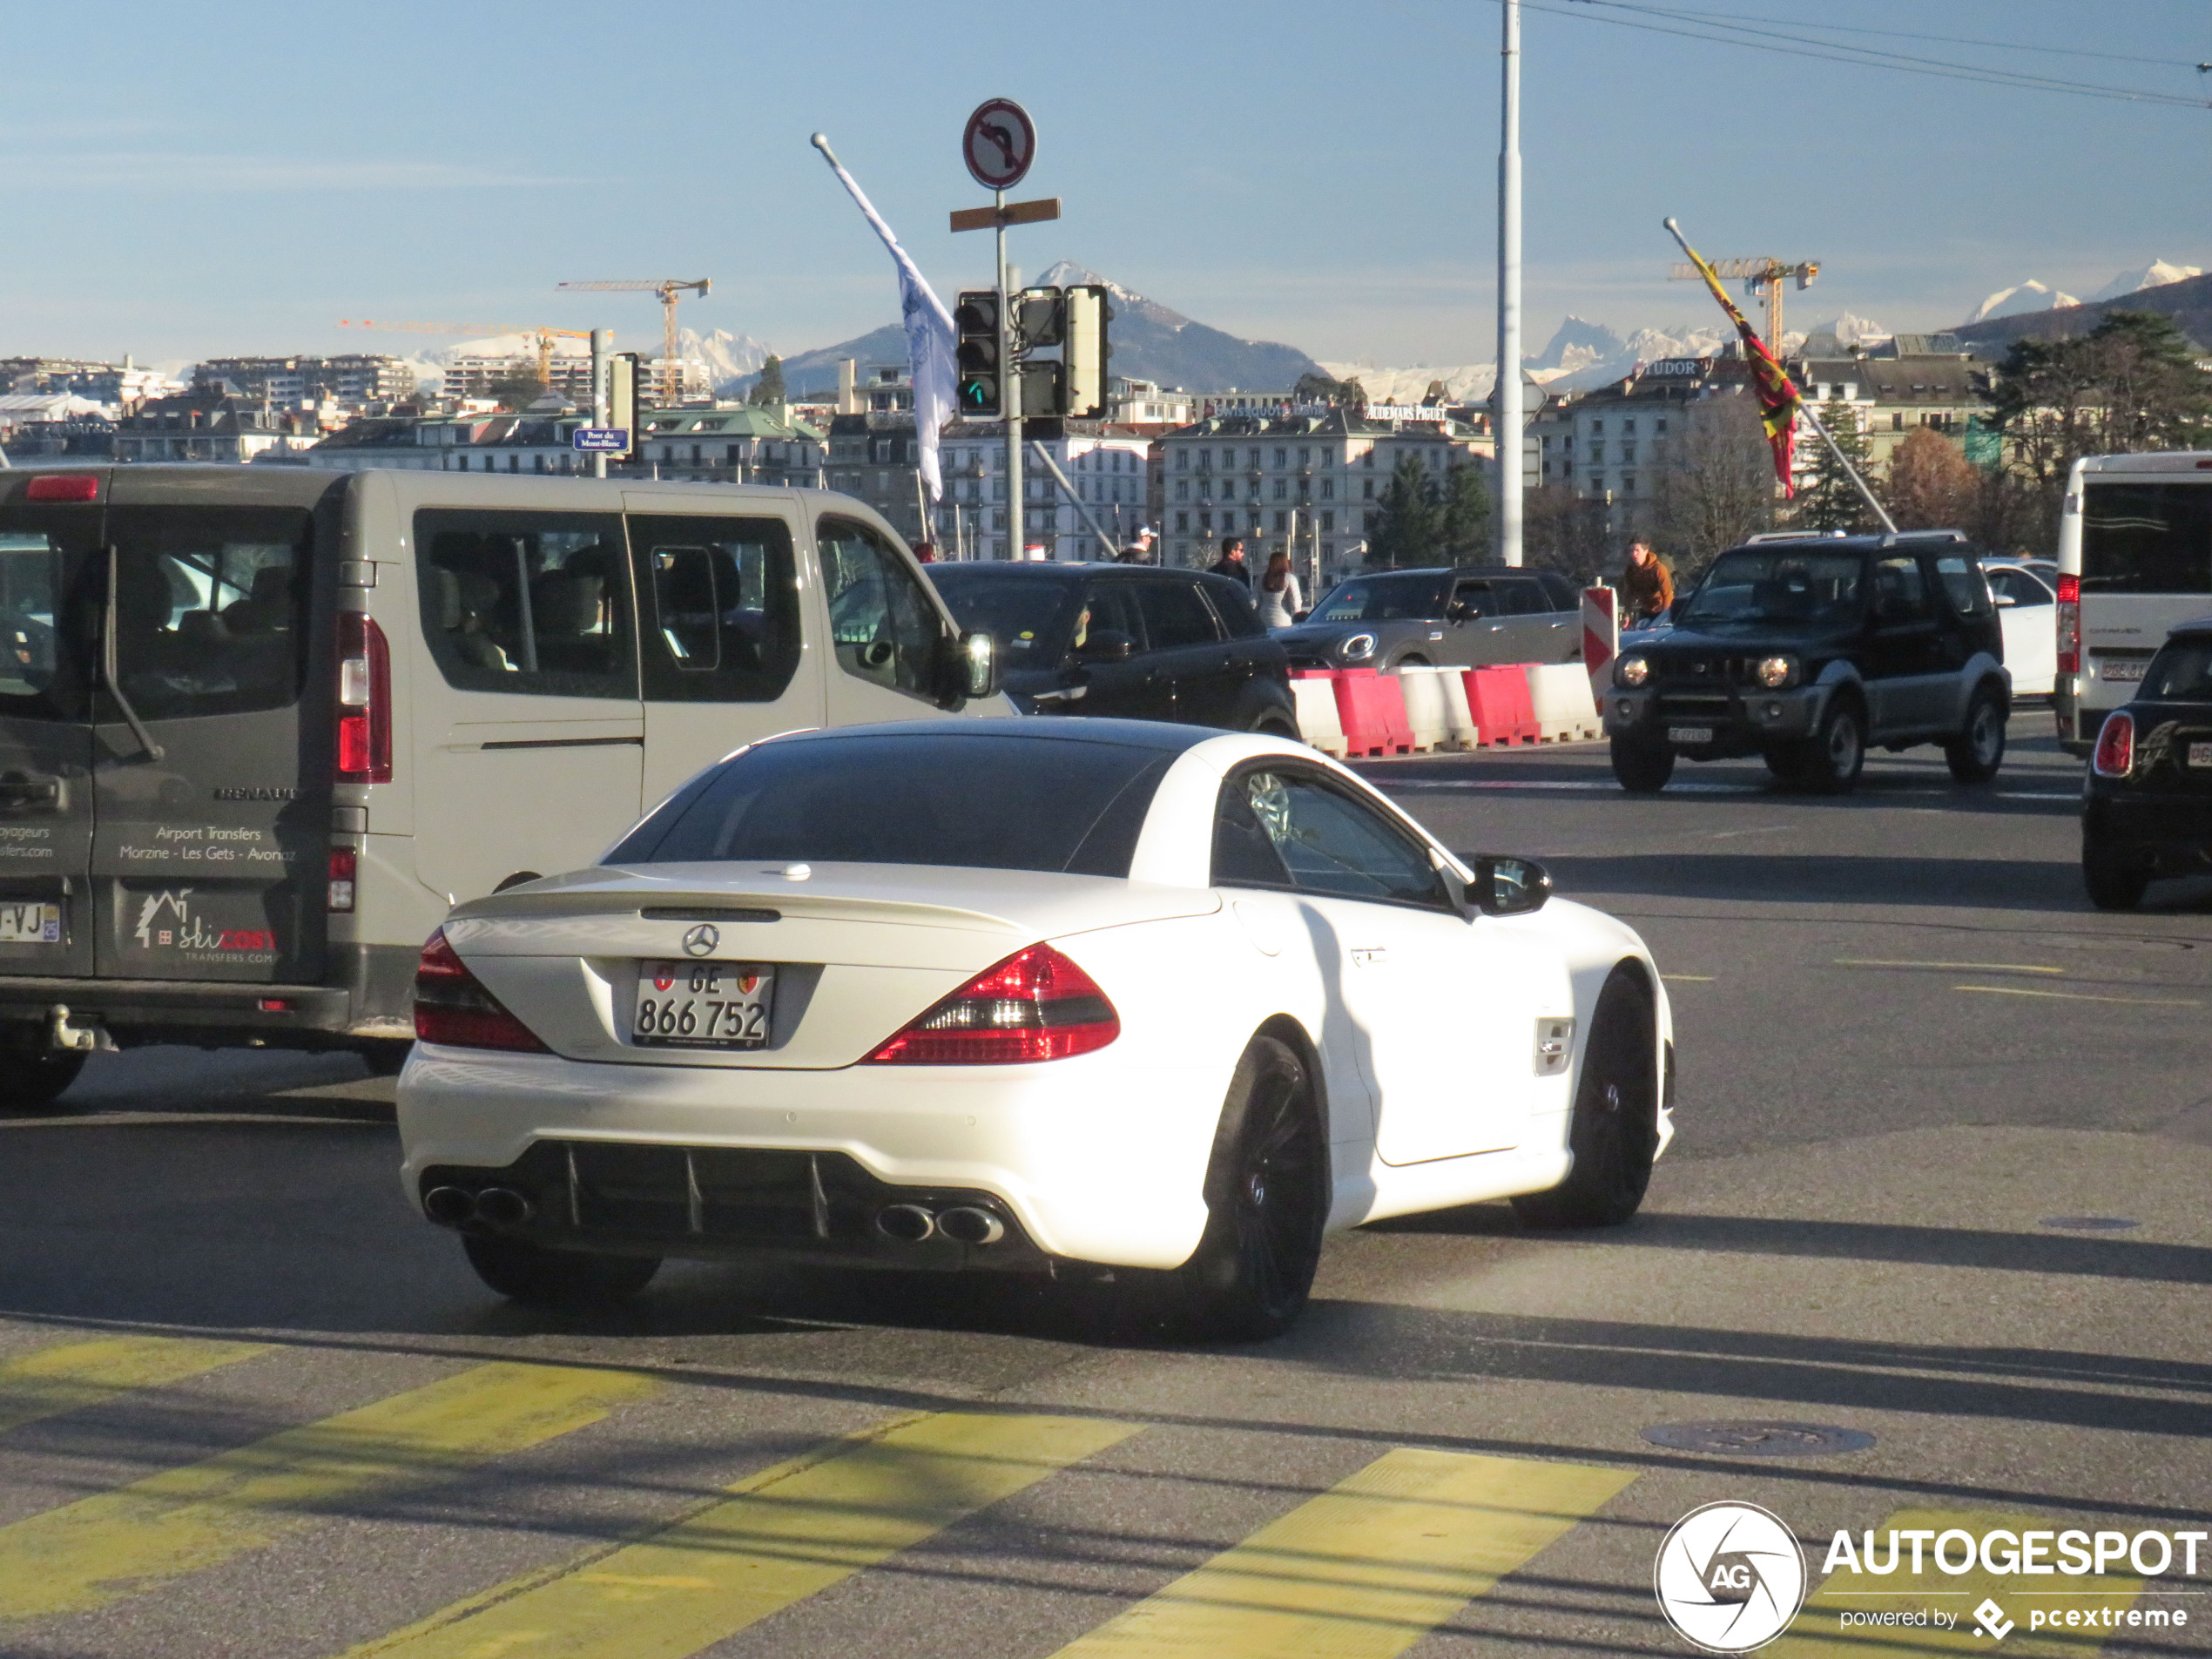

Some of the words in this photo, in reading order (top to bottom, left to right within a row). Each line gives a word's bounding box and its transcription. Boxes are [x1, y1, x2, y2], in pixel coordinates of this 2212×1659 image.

[1645, 361, 1696, 375] TUDOR
[1366, 405, 1414, 421] AUDEMARS
[1416, 407, 1447, 421] PIGUET
[156, 826, 202, 842] Airport
[207, 826, 261, 840] Transfers
[120, 846, 169, 860] Morzine
[183, 846, 201, 860] Les
[206, 846, 235, 860] Gets
[247, 847, 296, 861] Avoriaz
[185, 952, 273, 963] TRANSFERS.COM
[689, 966, 722, 994] GE
[637, 998, 697, 1034] 866
[706, 1001, 765, 1037] 752
